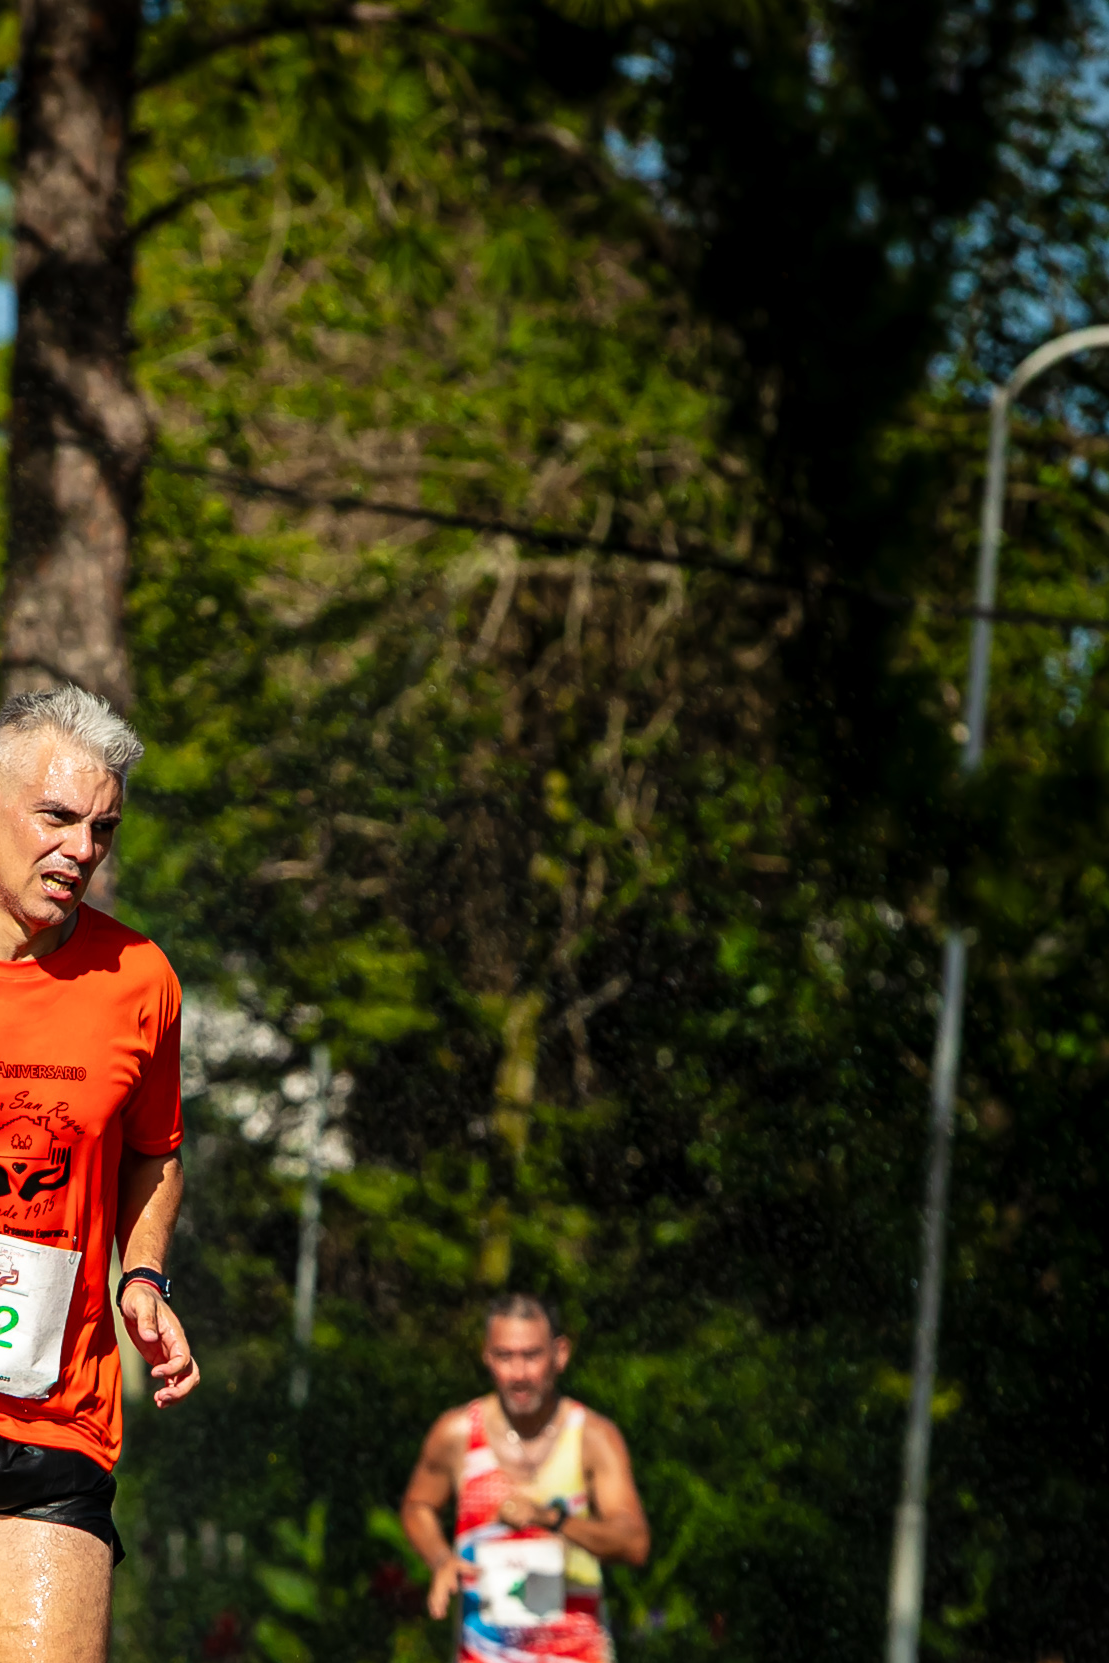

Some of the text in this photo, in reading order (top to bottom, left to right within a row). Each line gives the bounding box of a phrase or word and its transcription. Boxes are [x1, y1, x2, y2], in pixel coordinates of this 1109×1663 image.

[9, 1091, 43, 1111] San
[47, 1102, 85, 1135] Roque
[25, 1195, 56, 1220] 1975
